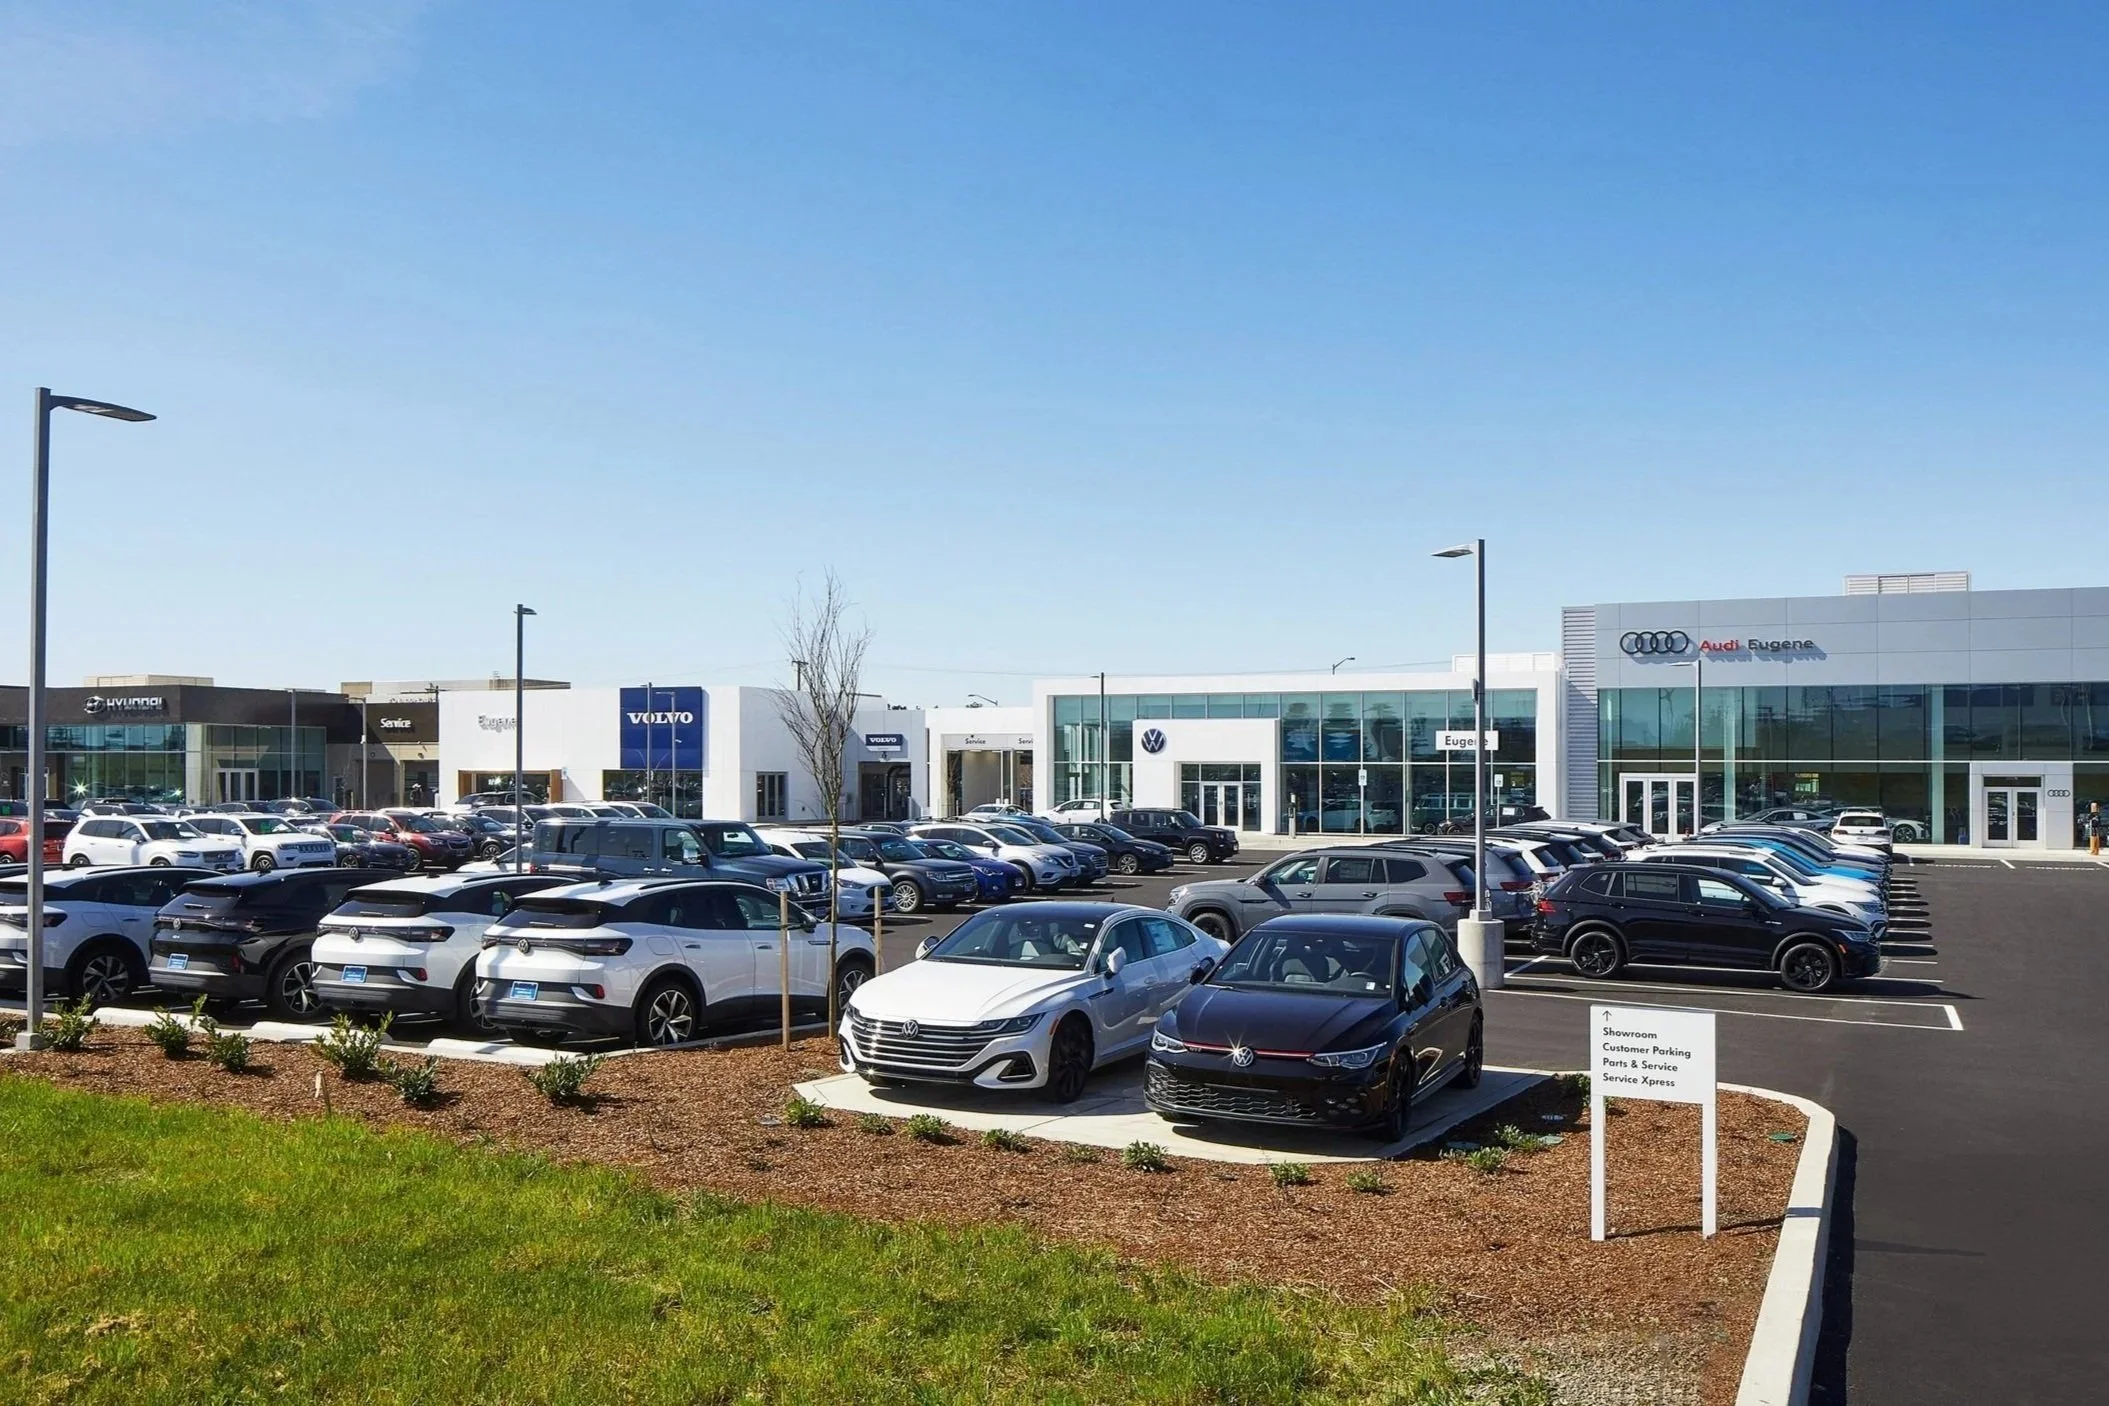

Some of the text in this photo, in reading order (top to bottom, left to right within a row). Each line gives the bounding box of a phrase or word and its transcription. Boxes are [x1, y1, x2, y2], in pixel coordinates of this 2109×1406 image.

[1700, 638, 1814, 652] Audi Eugene
[380, 718, 412, 728] Service
[627, 711, 694, 724] VOLVO
[1602, 1027, 1658, 1040] Showroom
[1602, 1042, 1692, 1060] Customer Parking
[1602, 1058, 1678, 1072] Parts & Service
[1602, 1073, 1676, 1088] Service Xpress
